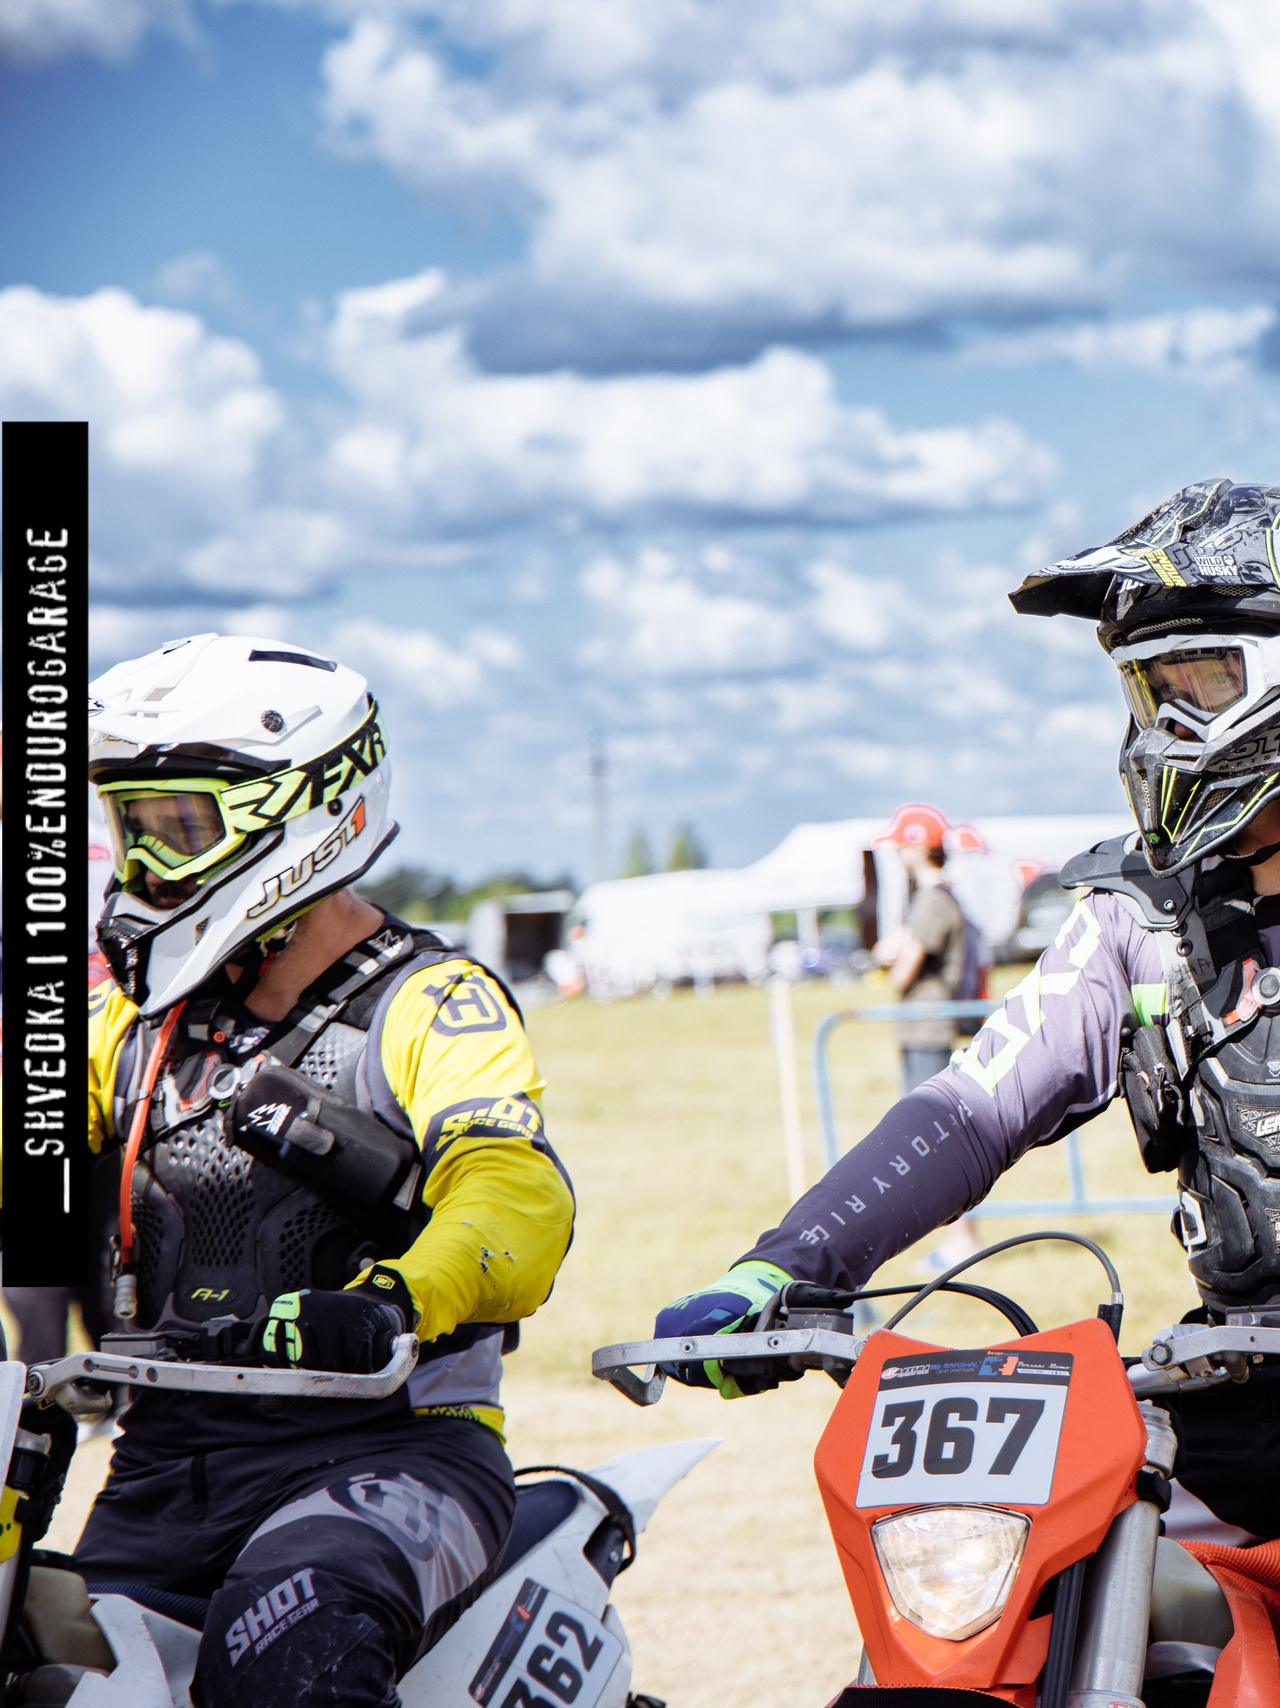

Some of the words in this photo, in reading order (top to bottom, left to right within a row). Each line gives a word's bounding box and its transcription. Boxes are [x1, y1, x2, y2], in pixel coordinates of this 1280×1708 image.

[1195, 557, 1222, 566] WILD
[1200, 565, 1238, 576] HUSKY
[246, 793, 366, 919] JUST1
[190, 1287, 231, 1301] A-1
[870, 1397, 1046, 1479] 367
[225, 1566, 316, 1668] SHOT
[254, 1618, 288, 1656] RACE
[286, 1597, 320, 1629] GEAR
